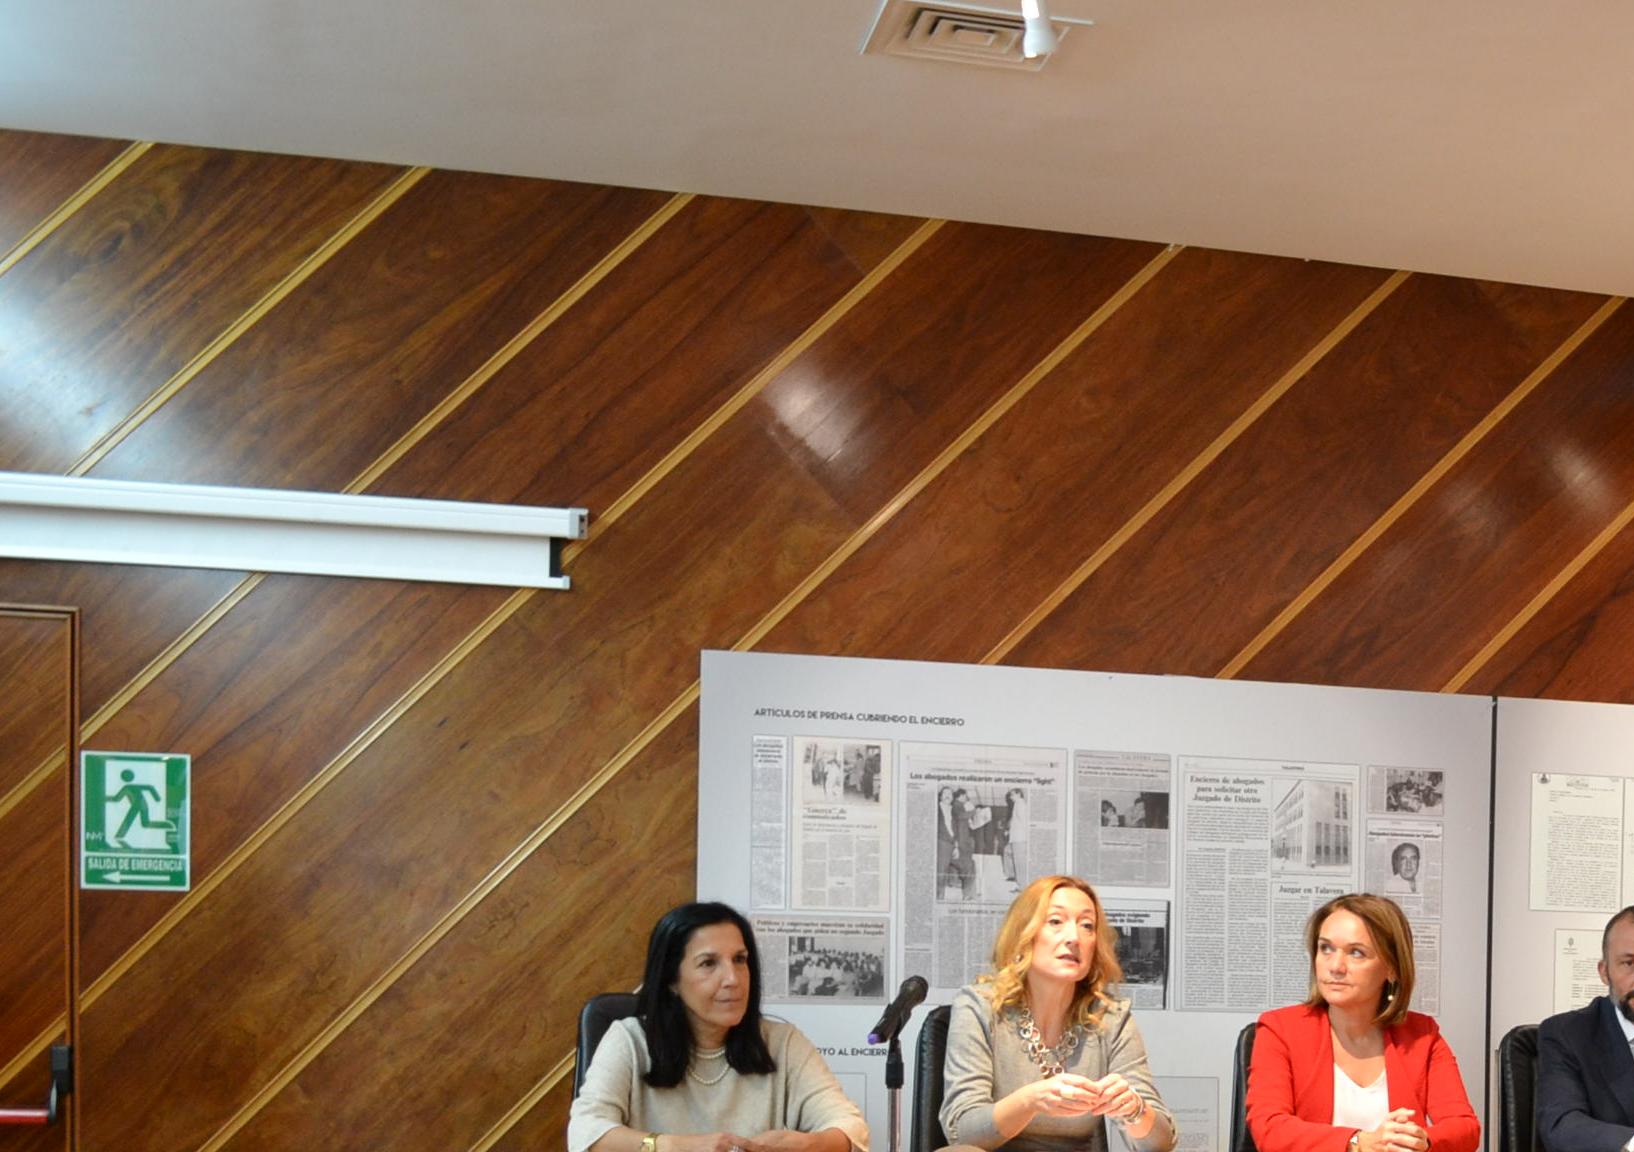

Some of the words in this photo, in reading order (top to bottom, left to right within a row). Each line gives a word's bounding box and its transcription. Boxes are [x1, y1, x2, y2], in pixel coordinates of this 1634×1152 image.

[807, 710, 818, 720] DE
[820, 711, 854, 721] PRENSA
[857, 713, 907, 724] CUBRIENDO
[909, 715, 919, 724] EL
[921, 716, 965, 727] ENCIERRO
[924, 773, 957, 782] abogados
[1222, 776, 1230, 784] de
[1232, 777, 1264, 787] abogados
[1196, 786, 1212, 794] para
[1214, 785, 1241, 794] solicitar
[1192, 794, 1221, 803] Juzgado
[1224, 795, 1232, 803] de
[1234, 795, 1261, 804] Distrito
[88, 857, 117, 869] SALIDA
[118, 858, 130, 870] DE
[131, 858, 183, 871] EMERGENCIA
[1315, 886, 1344, 895] Talavera
[838, 1048, 848, 1056] AL
[851, 1048, 887, 1057] ENCIERR
